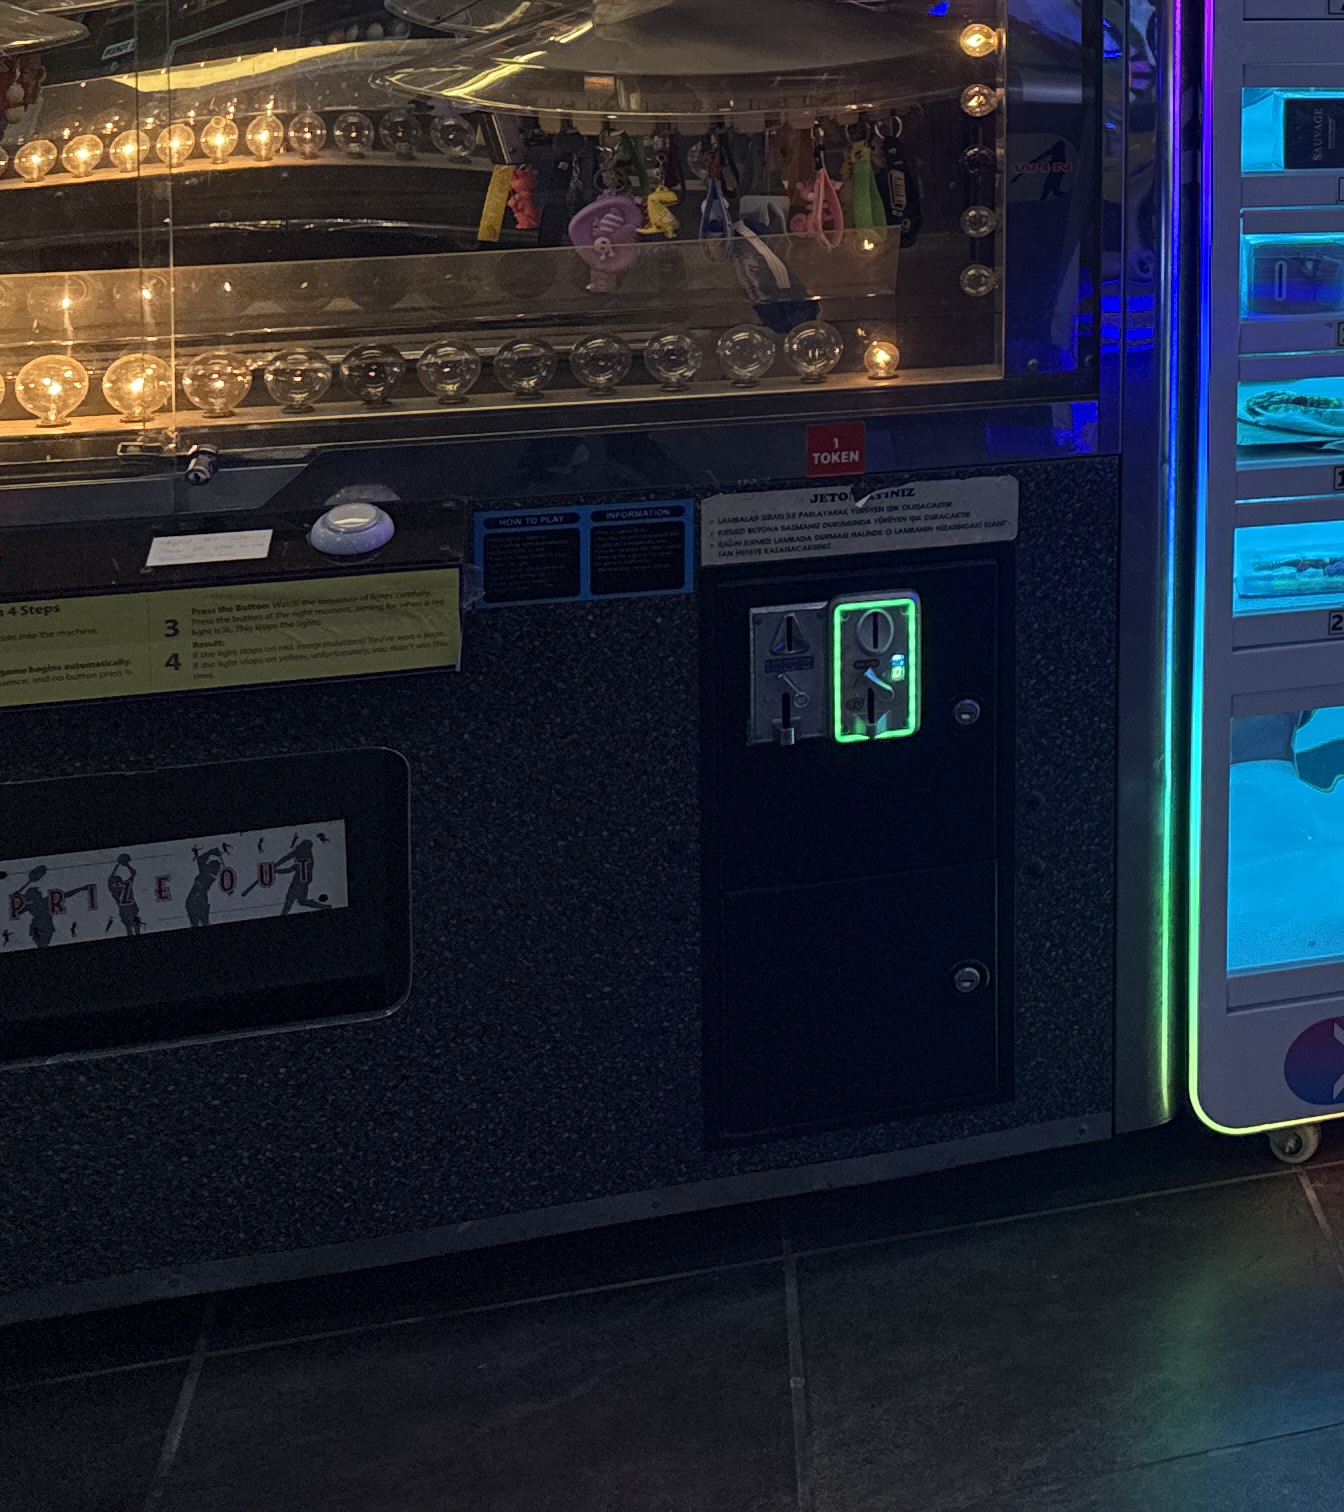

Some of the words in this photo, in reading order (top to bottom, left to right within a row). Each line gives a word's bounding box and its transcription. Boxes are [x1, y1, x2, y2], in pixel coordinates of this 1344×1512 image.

[1312, 107, 1324, 162] SAUVAGE
[1012, 162, 1073, 174] WIN
[832, 437, 839, 449] 1
[811, 450, 860, 465] TOKEN
[809, 491, 853, 504] JETO
[606, 508, 671, 520] INFORMATION
[499, 519, 522, 527] HOW
[525, 517, 537, 525] TO
[540, 515, 565, 524] PLAY
[7, 606, 17, 617] 4
[20, 604, 61, 617] Steps
[163, 618, 181, 638] 3
[164, 652, 182, 671] 4
[8, 873, 172, 922] PRIZE
[218, 856, 315, 896] OUT
